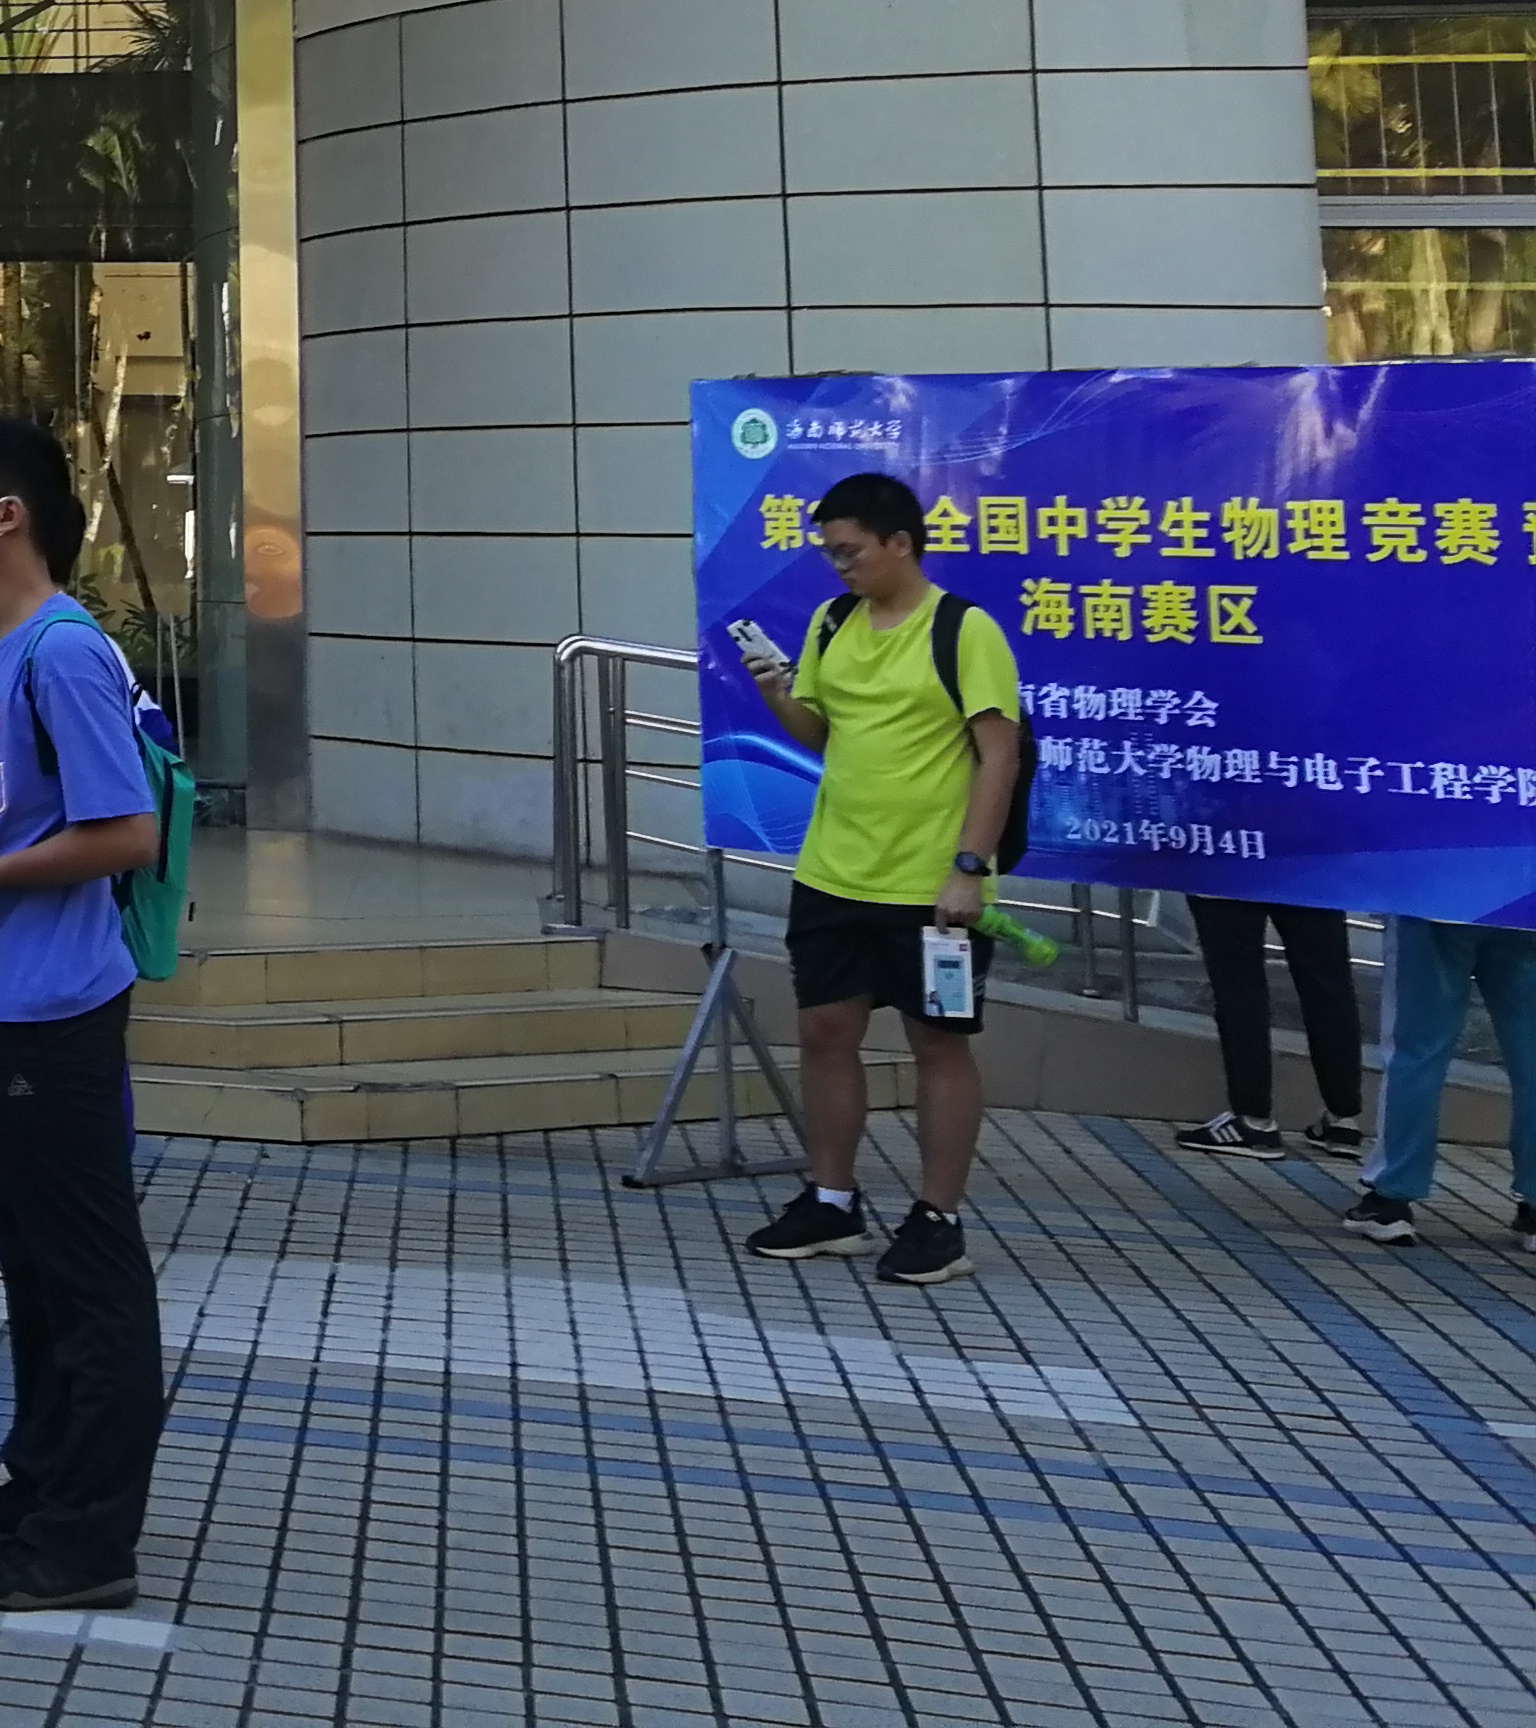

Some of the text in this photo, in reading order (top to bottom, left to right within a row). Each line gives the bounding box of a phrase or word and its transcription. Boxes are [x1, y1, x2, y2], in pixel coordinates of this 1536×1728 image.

[1019, 577, 1264, 646] 海南赛区
[1065, 818, 1266, 860] 2021年9月4日
